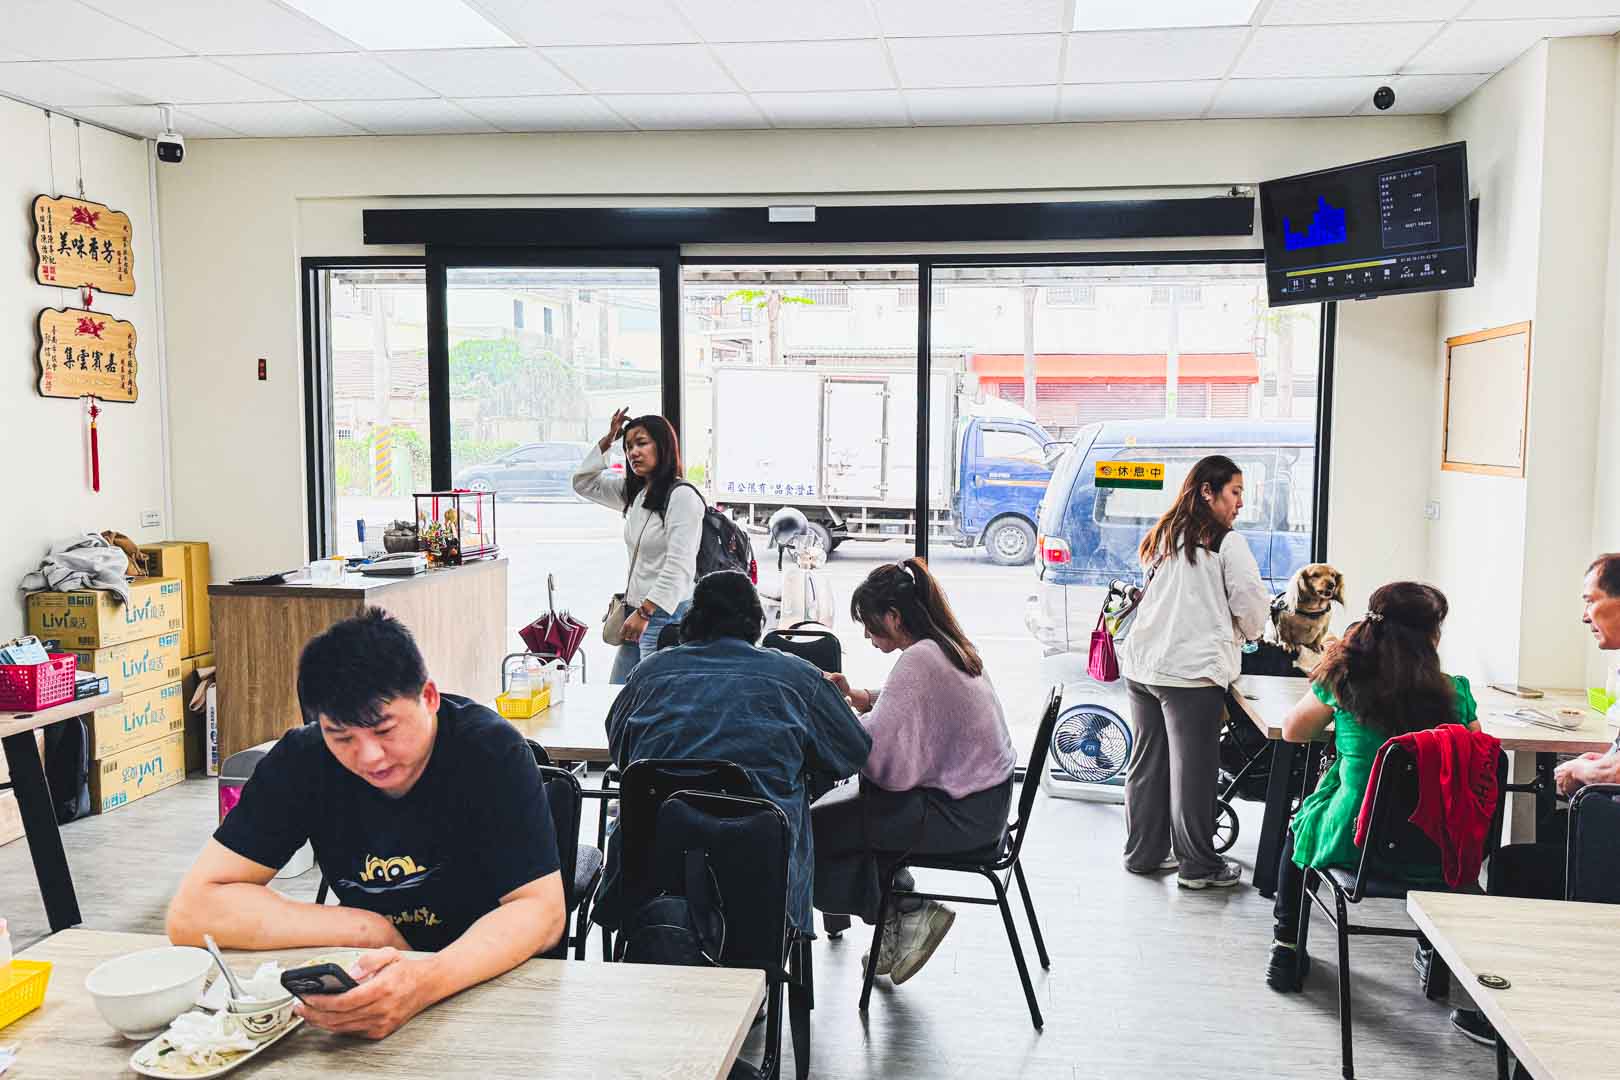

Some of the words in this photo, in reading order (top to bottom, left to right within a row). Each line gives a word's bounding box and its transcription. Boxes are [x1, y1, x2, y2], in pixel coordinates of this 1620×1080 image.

[42, 609, 70, 628] Livi
[126, 597, 151, 624] Livi
[122, 649, 149, 678] Livi
[124, 702, 151, 731] Livi
